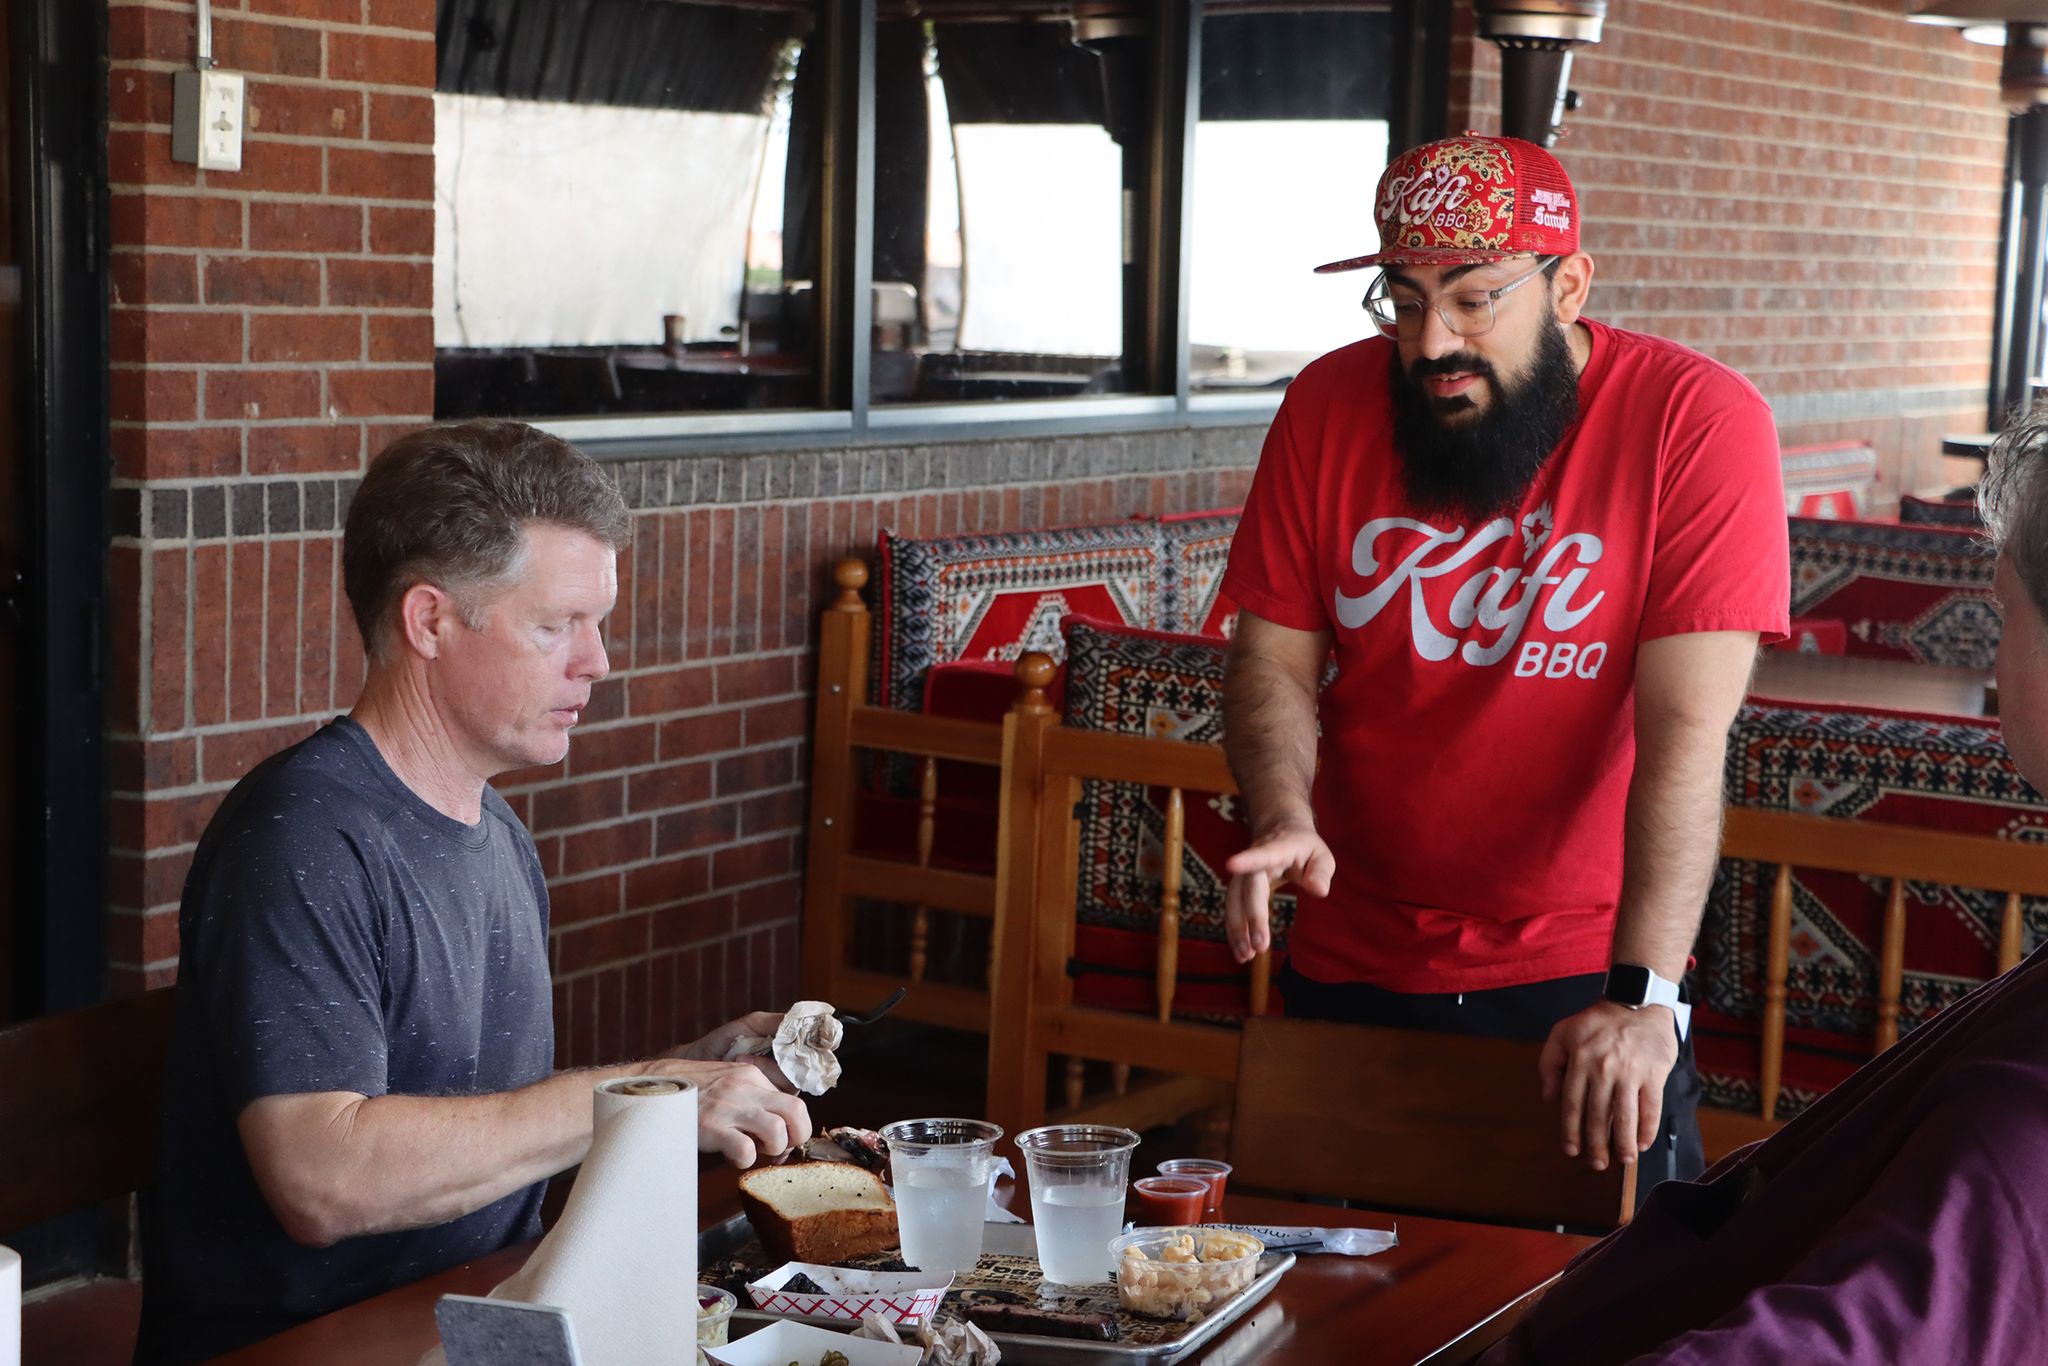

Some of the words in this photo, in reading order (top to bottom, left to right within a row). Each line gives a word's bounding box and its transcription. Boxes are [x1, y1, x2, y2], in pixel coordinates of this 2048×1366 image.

[1382, 170, 1467, 225] Kafi
[1434, 213, 1467, 229] BBQ
[1335, 517, 1605, 666] Kafi
[1514, 641, 1608, 680] BBQ
